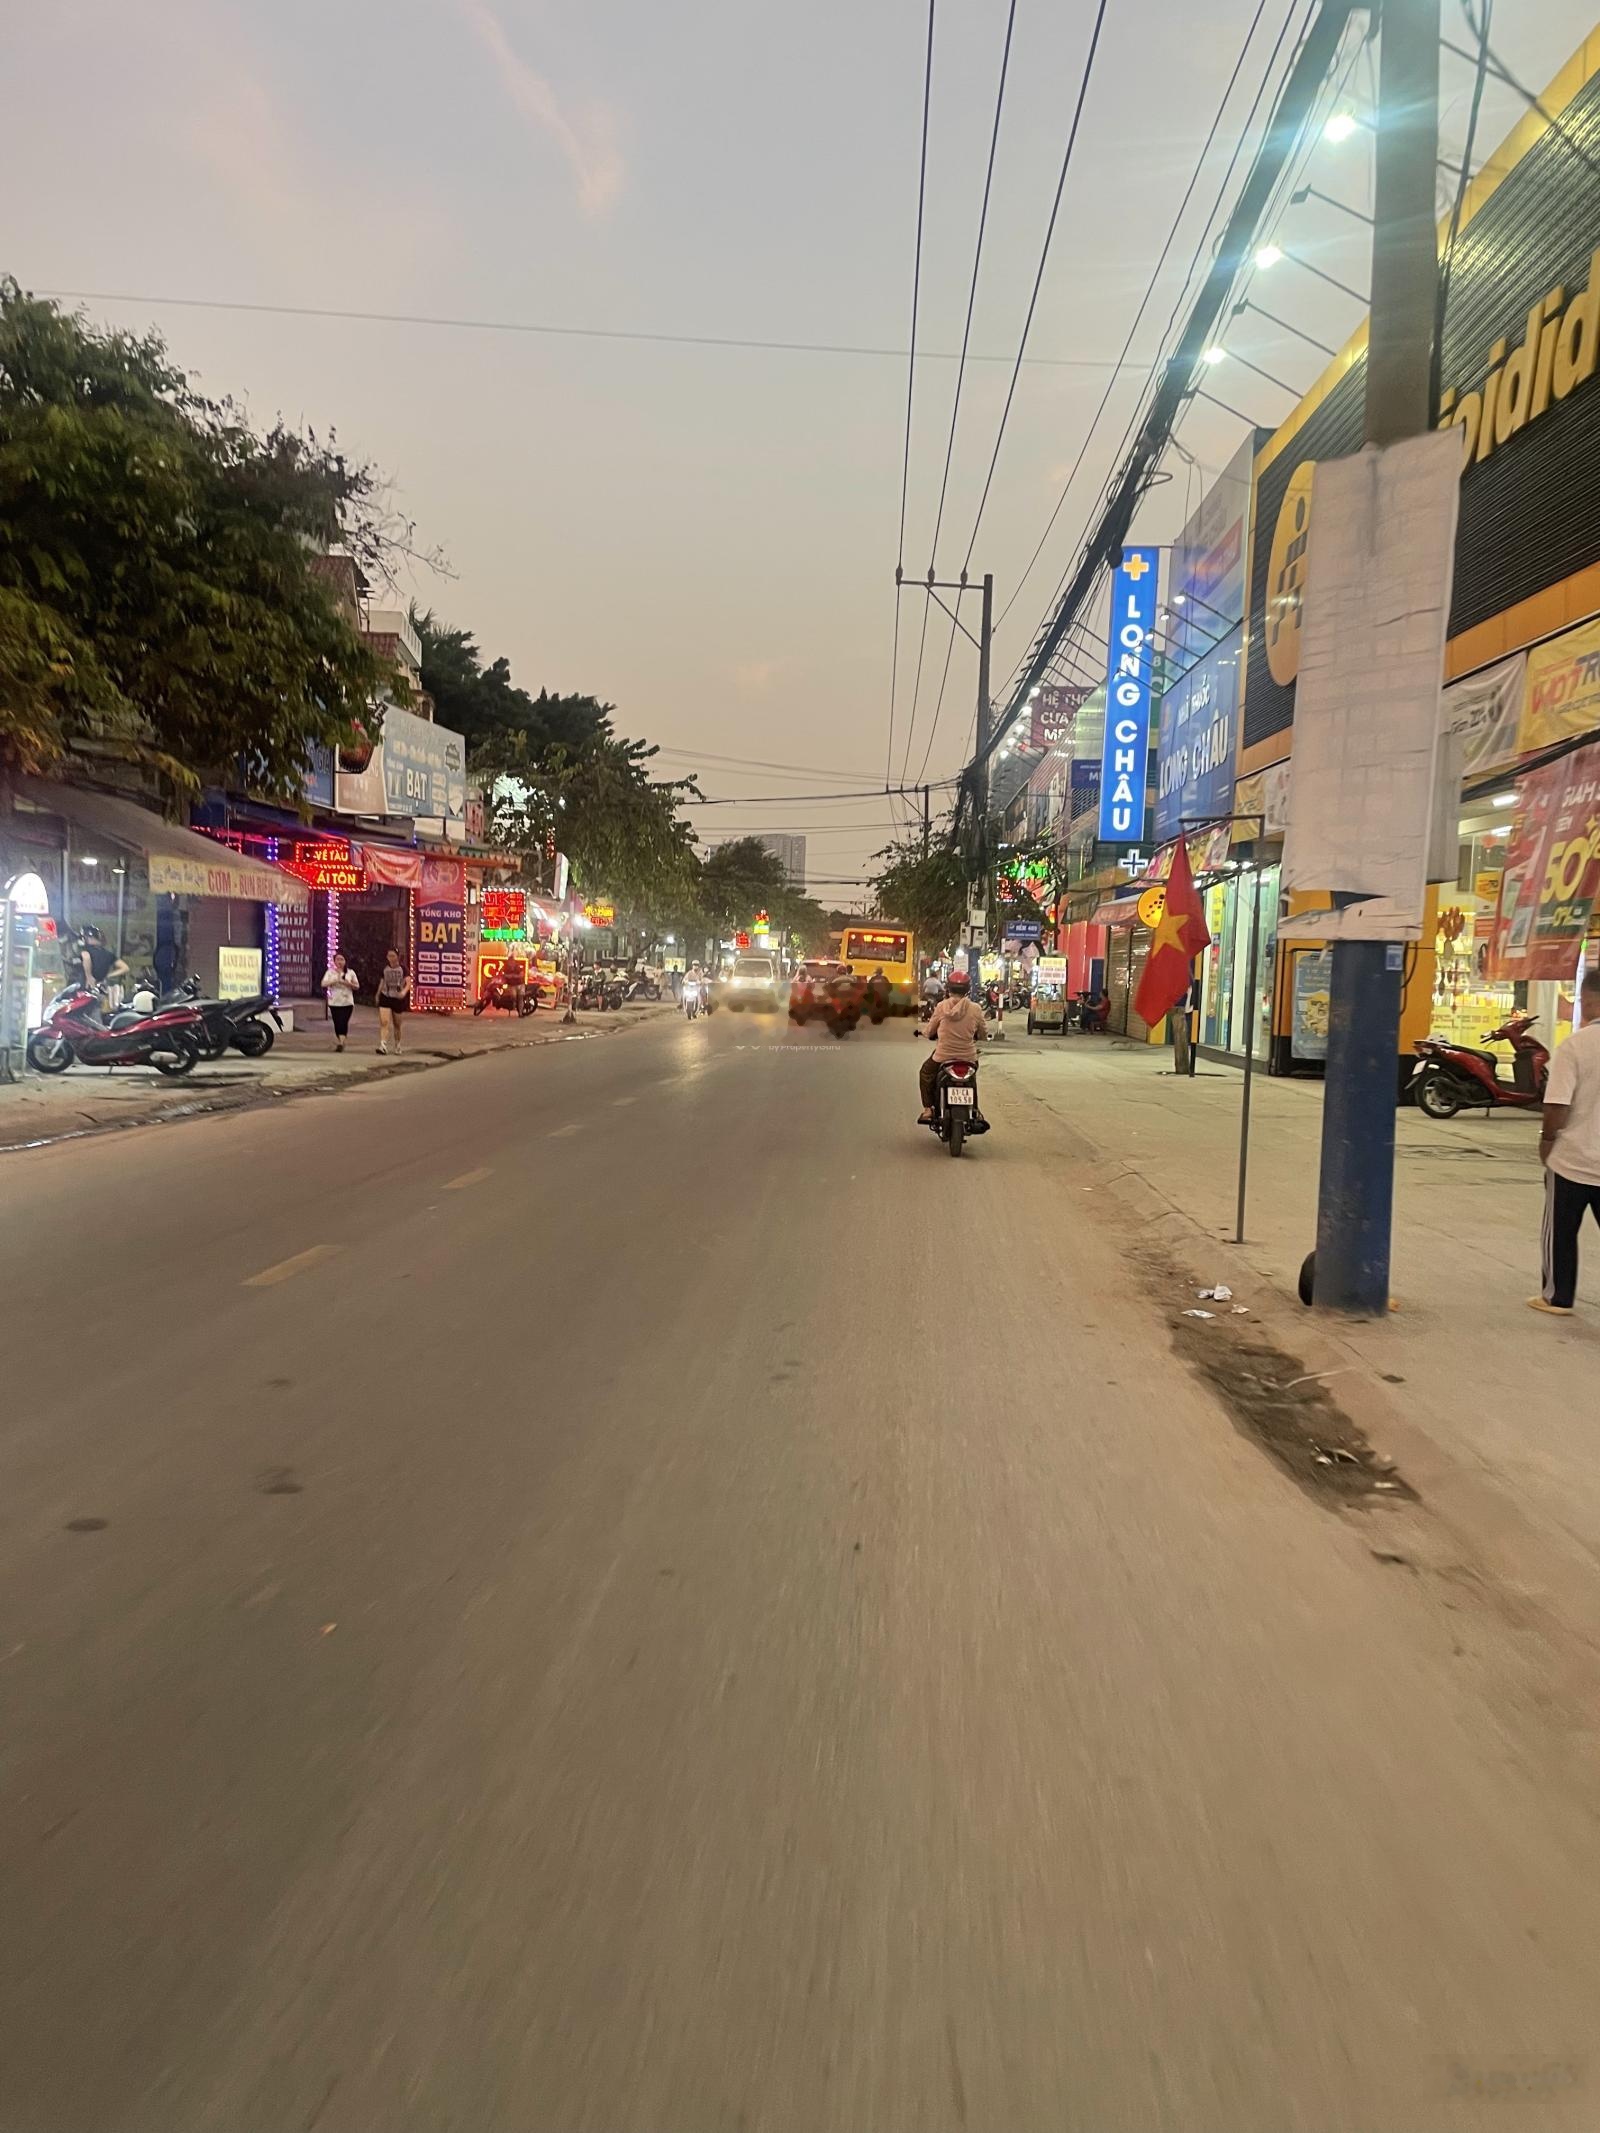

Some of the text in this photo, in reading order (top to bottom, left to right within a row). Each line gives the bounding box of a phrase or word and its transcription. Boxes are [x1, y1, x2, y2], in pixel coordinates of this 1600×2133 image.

[1111, 595, 1144, 831] LONG CHÂU
[1159, 708, 1229, 800] LONG CHÂU
[406, 768, 428, 808] BẠT
[332, 871, 356, 885] TÔN
[420, 908, 462, 919] TỔNG KHO
[420, 921, 461, 949] BẠT
